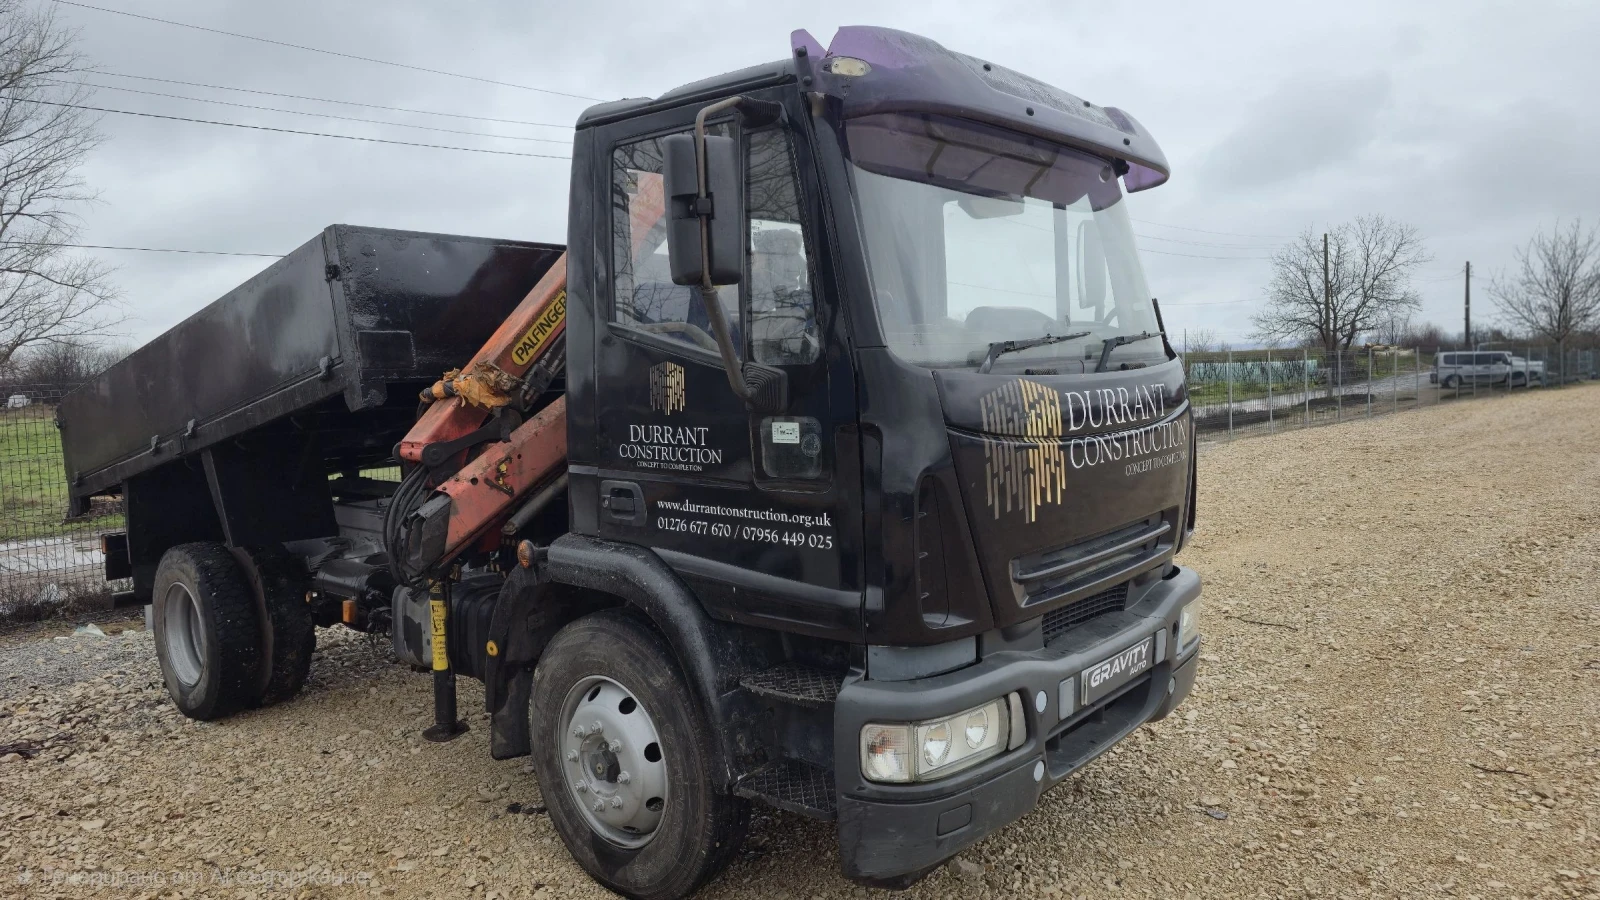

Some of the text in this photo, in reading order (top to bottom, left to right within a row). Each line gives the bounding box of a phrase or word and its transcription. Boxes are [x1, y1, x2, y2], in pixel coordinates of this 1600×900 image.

[1065, 383, 1164, 431] DURRANT
[630, 425, 708, 445] DURRANT
[1070, 419, 1187, 469] CONSTRUCTION
[619, 444, 722, 464] CONSTRUCTION
[637, 460, 659, 468] CONCEPT
[668, 463, 702, 471] COMPLETION
[657, 499, 831, 527] www.durrantconstruction.org.uk
[657, 516, 833, 549] 01276 677 670 / 07956 449 025
[1090, 641, 1149, 687] GRAVITY
[1130, 660, 1147, 675] AUTO
